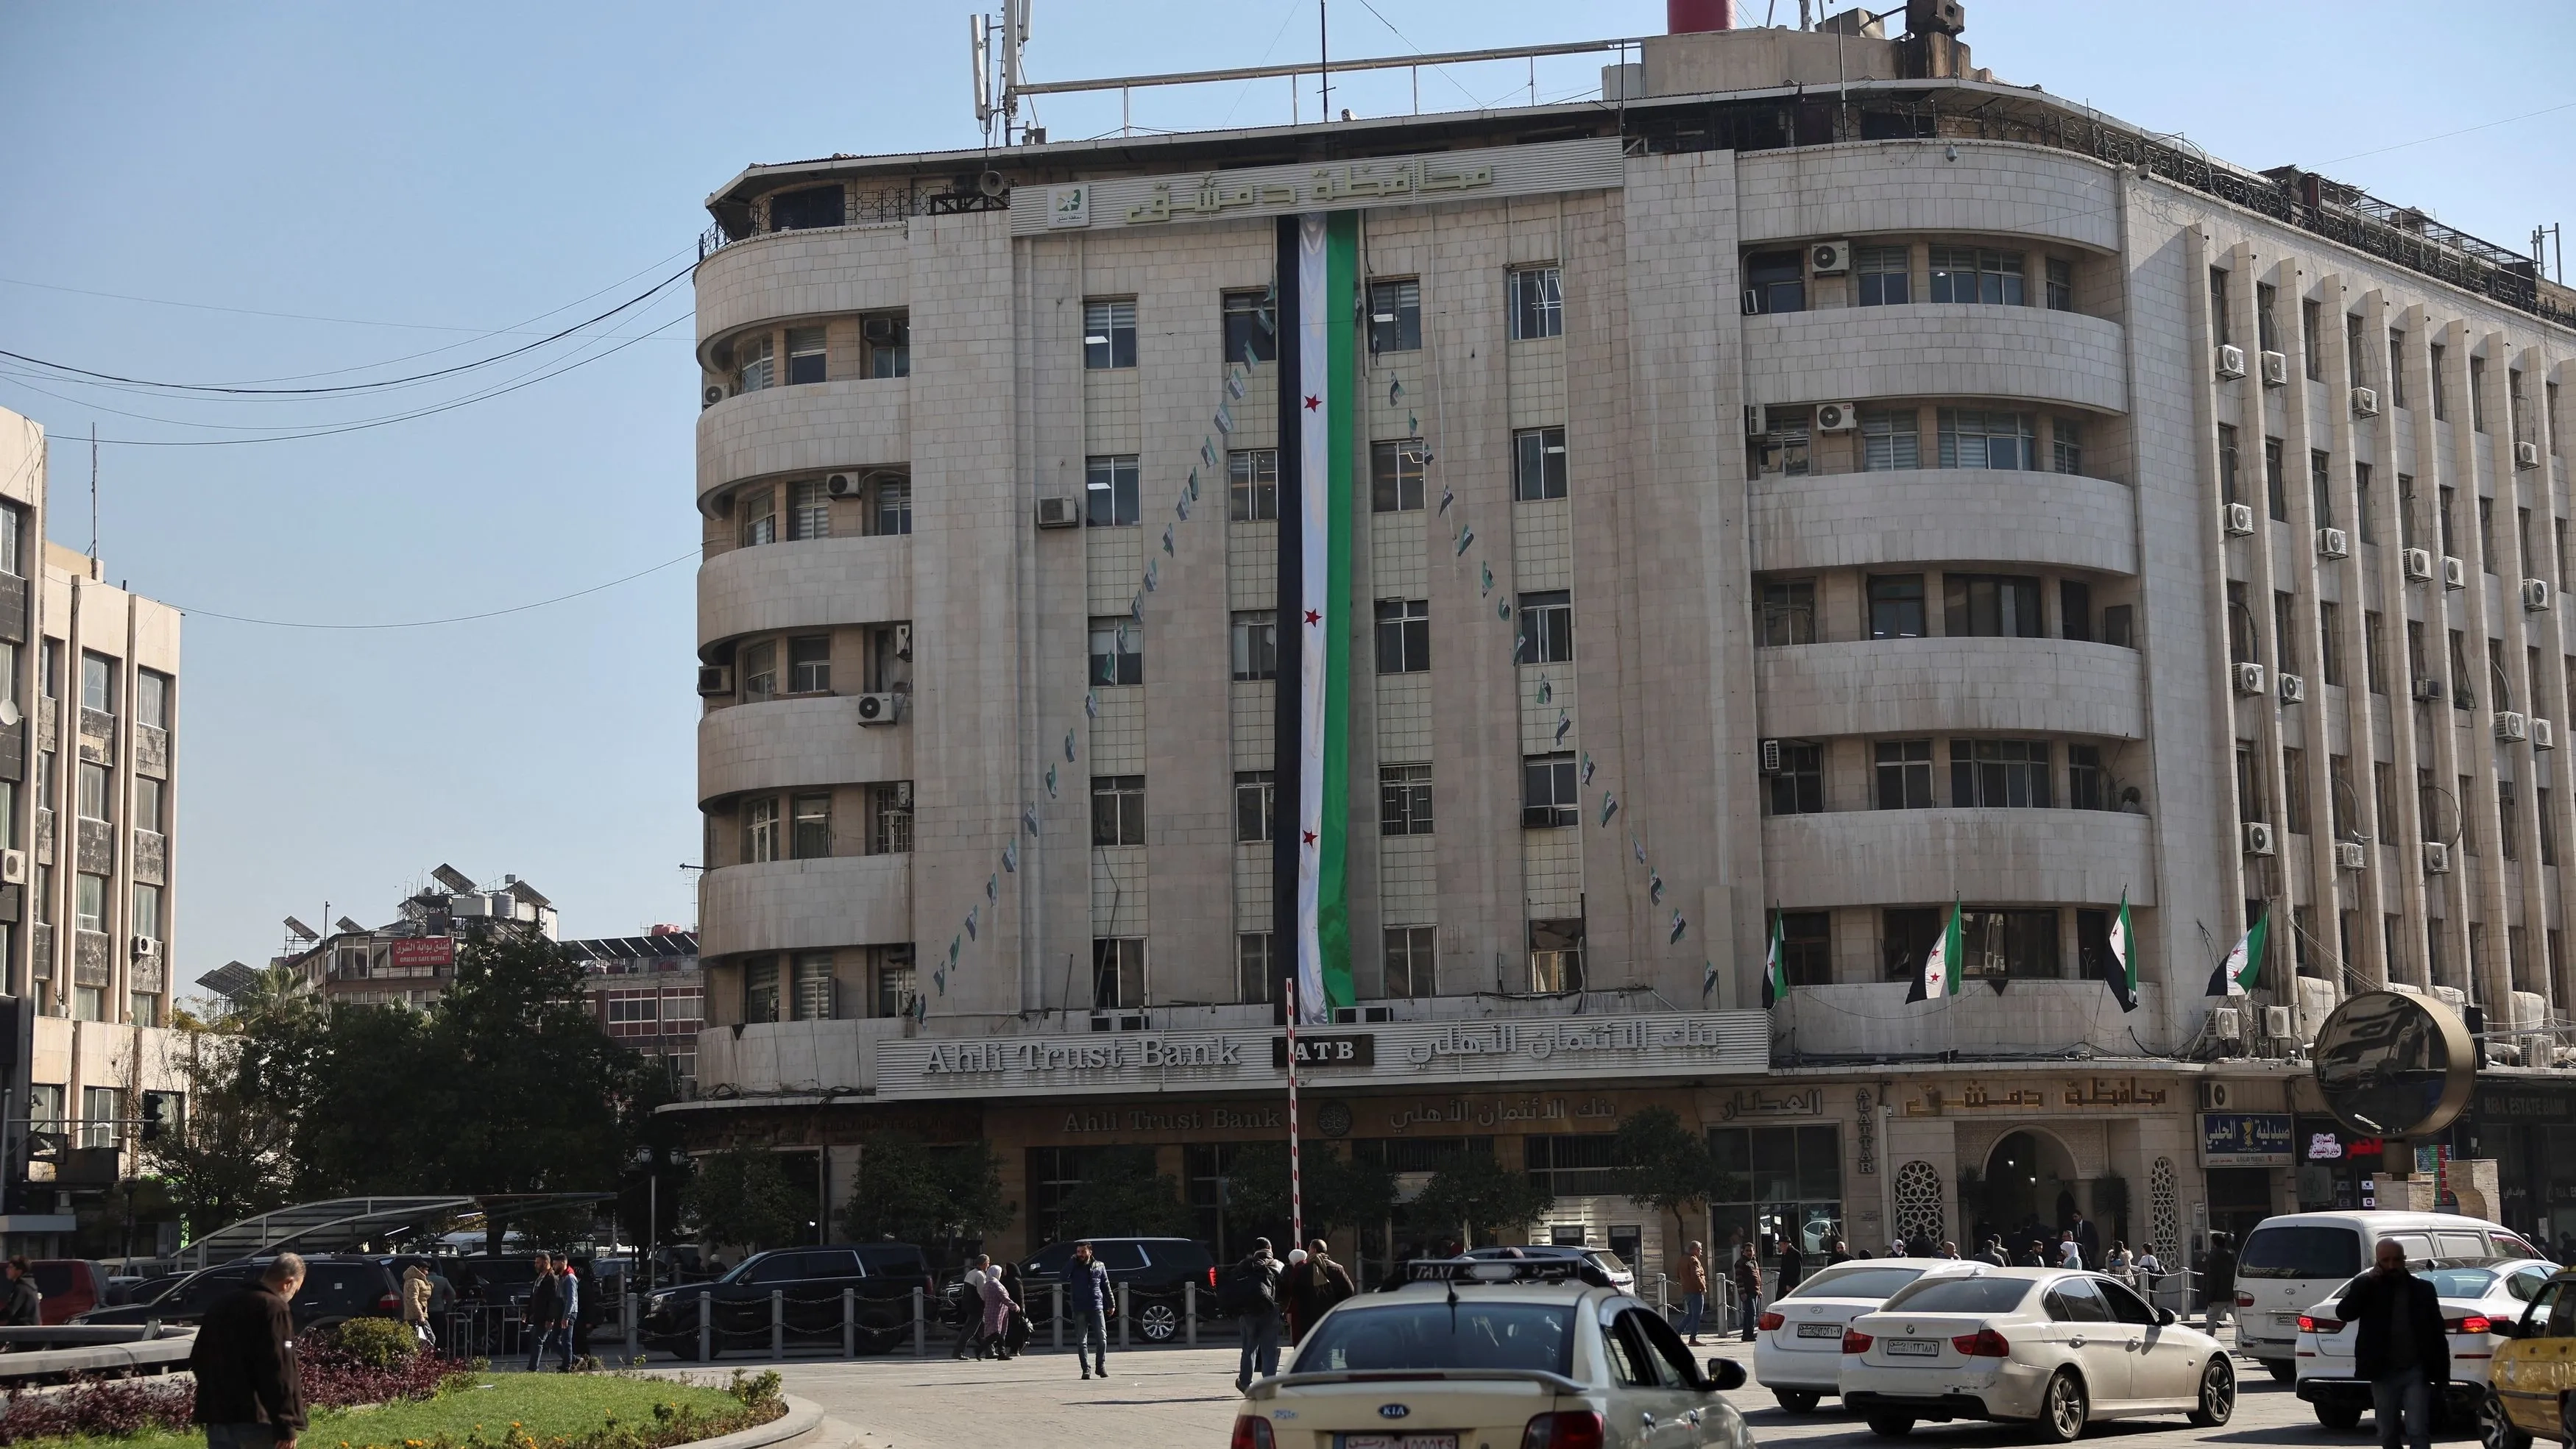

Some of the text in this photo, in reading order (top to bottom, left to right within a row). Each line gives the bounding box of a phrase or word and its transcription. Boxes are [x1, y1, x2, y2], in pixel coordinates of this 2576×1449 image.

[1125, 162, 1493, 224] محافظة دمشق
[396, 940, 450, 954] فندق بوابة الشرق
[1295, 1041, 1354, 1060] ATB
[1406, 1023, 1517, 1070] الأهلي
[1658, 1020, 1720, 1054] بنك
[921, 1034, 1242, 1074] Ahli Trust Bank
[1722, 1088, 1822, 1121] العطار
[2064, 1076, 2167, 1107] محافظة
[2509, 1096, 2541, 1115] ESTATE
[2541, 1095, 2568, 1115] BANK
[1062, 1108, 1282, 1133] Ahli Trust Bank
[1574, 1099, 1618, 1122] بنك
[1855, 1088, 1875, 1174] ALATTAR
[2205, 1119, 2290, 1150] صيدلية الحلبي
[1416, 1265, 1456, 1279] TAXI
[1383, 1406, 1406, 1416] KIA
